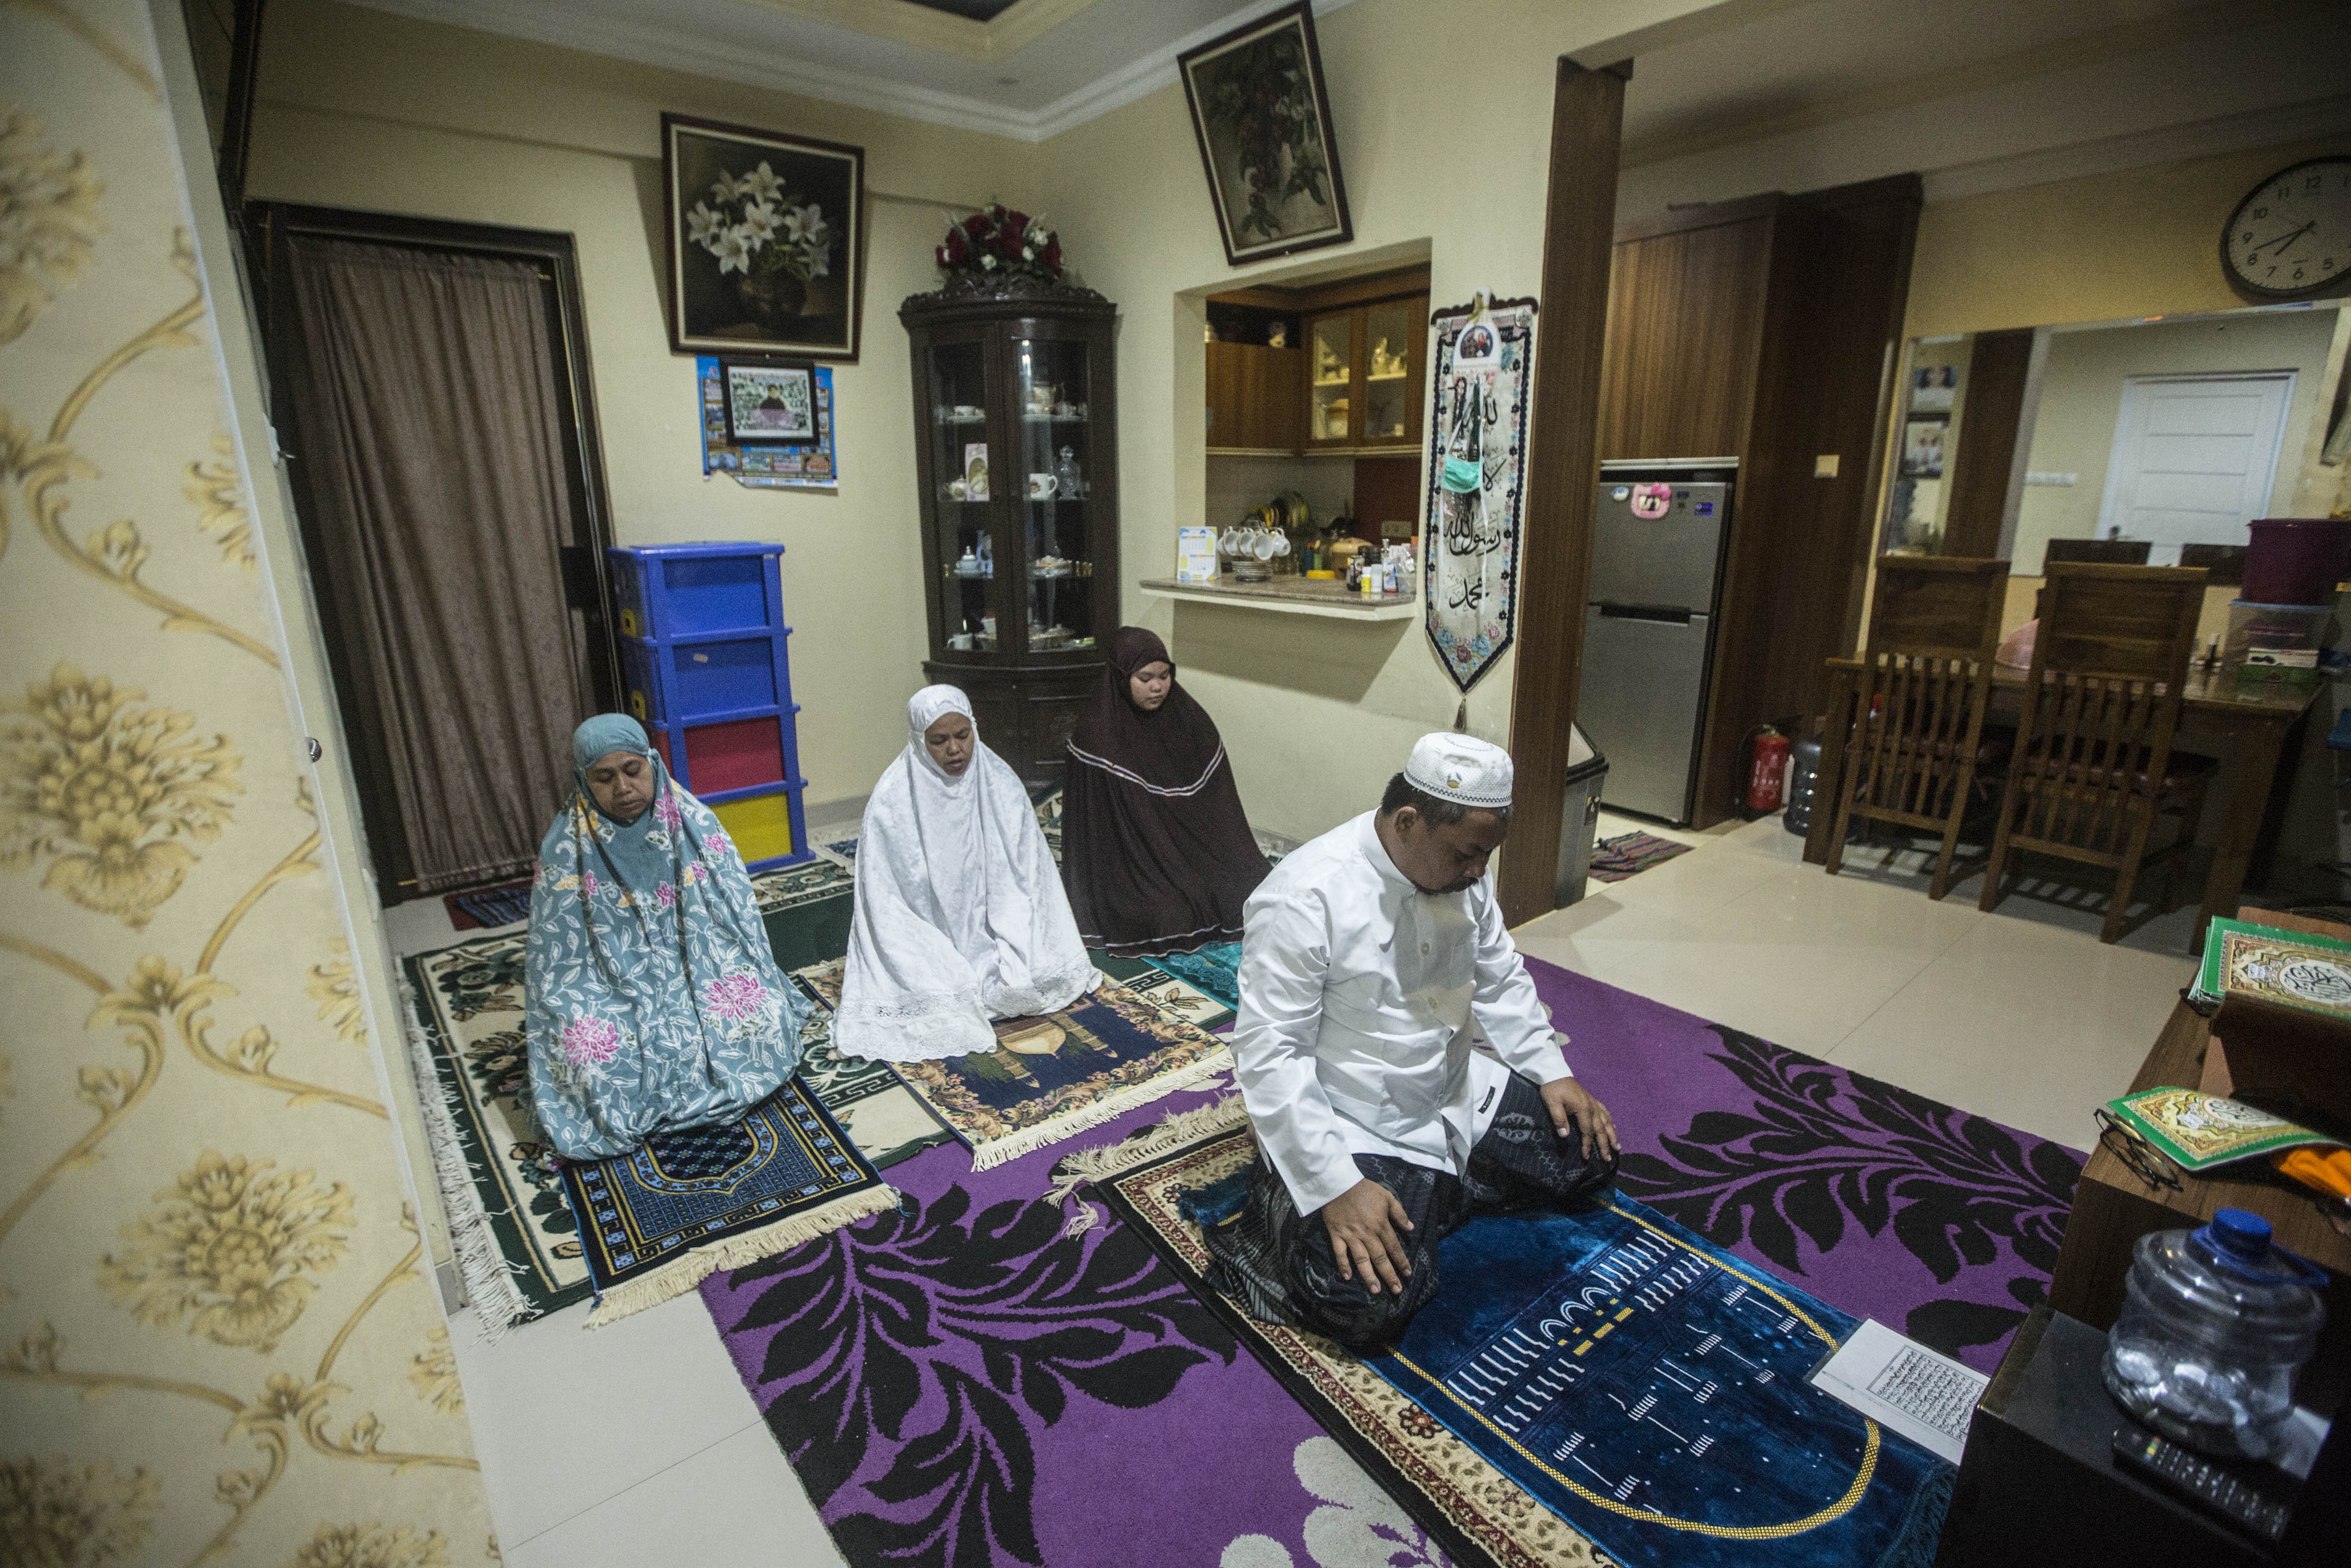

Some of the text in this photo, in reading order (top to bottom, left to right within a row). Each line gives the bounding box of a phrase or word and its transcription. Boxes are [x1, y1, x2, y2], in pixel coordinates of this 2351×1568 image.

[2307, 176, 2322, 188] 12
[2277, 187, 2289, 200] 11
[2253, 207, 2267, 221] 10
[2243, 232, 2254, 244] 9
[2247, 253, 2258, 265] 8
[2323, 258, 2334, 270] 5
[2267, 266, 2276, 279] 7
[2293, 267, 2304, 280] 6
